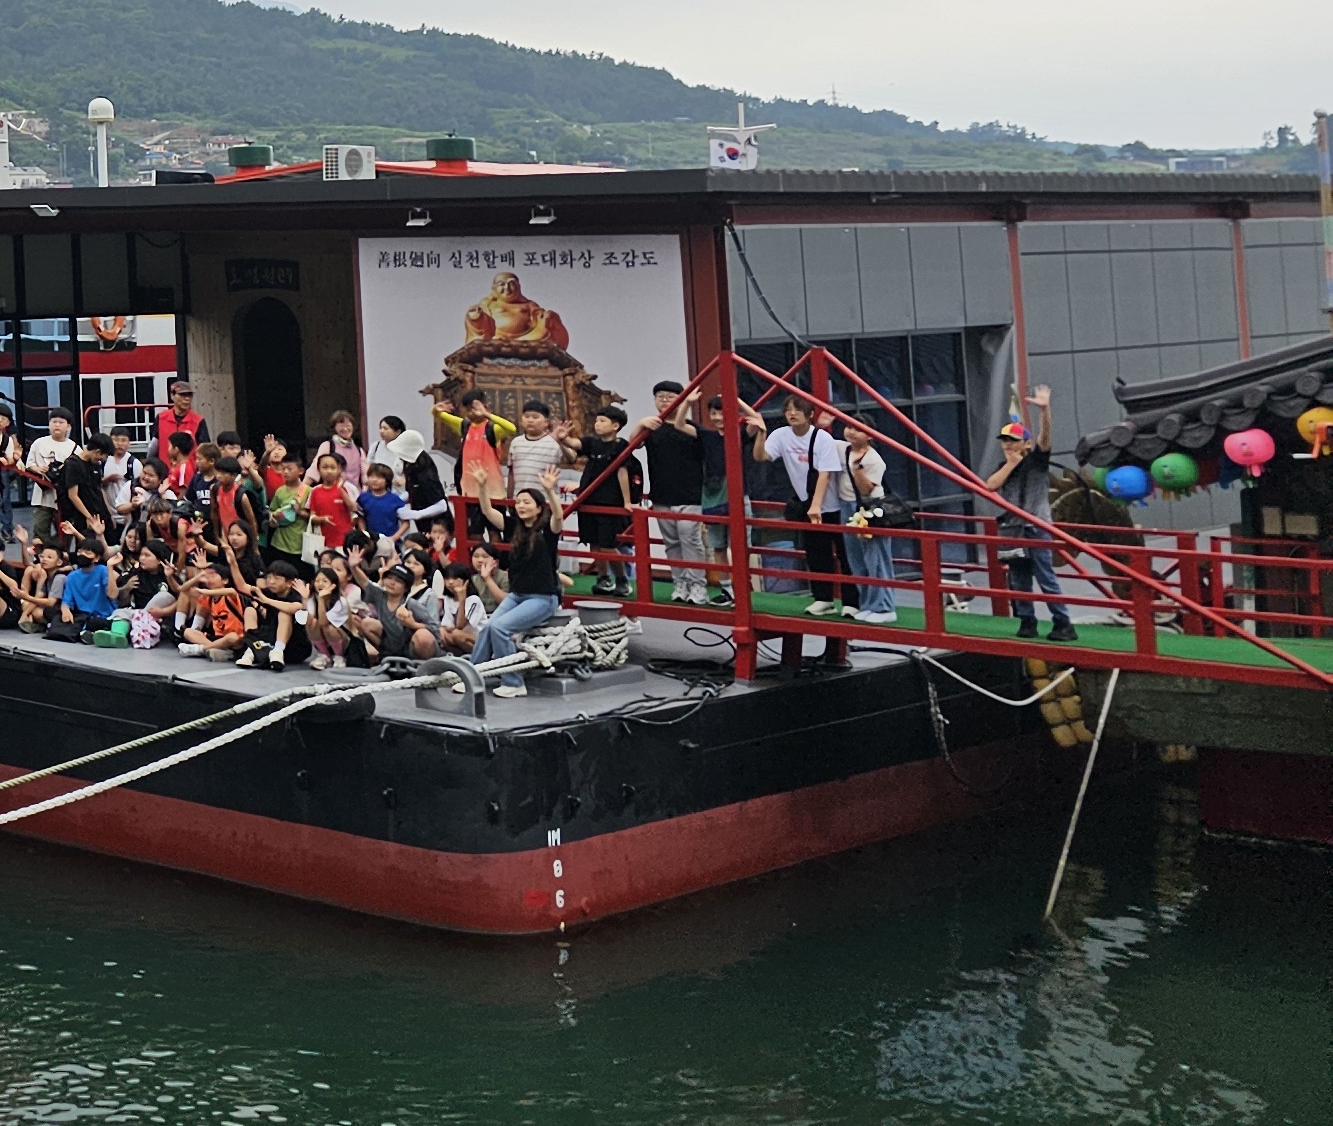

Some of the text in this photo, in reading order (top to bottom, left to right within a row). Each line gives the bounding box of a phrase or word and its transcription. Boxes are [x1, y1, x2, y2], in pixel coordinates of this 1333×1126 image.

[448, 249, 516, 269] 실천할배
[523, 249, 595, 269] 포대화상
[602, 249, 659, 269] 조감도
[555, 889, 565, 909] 6
